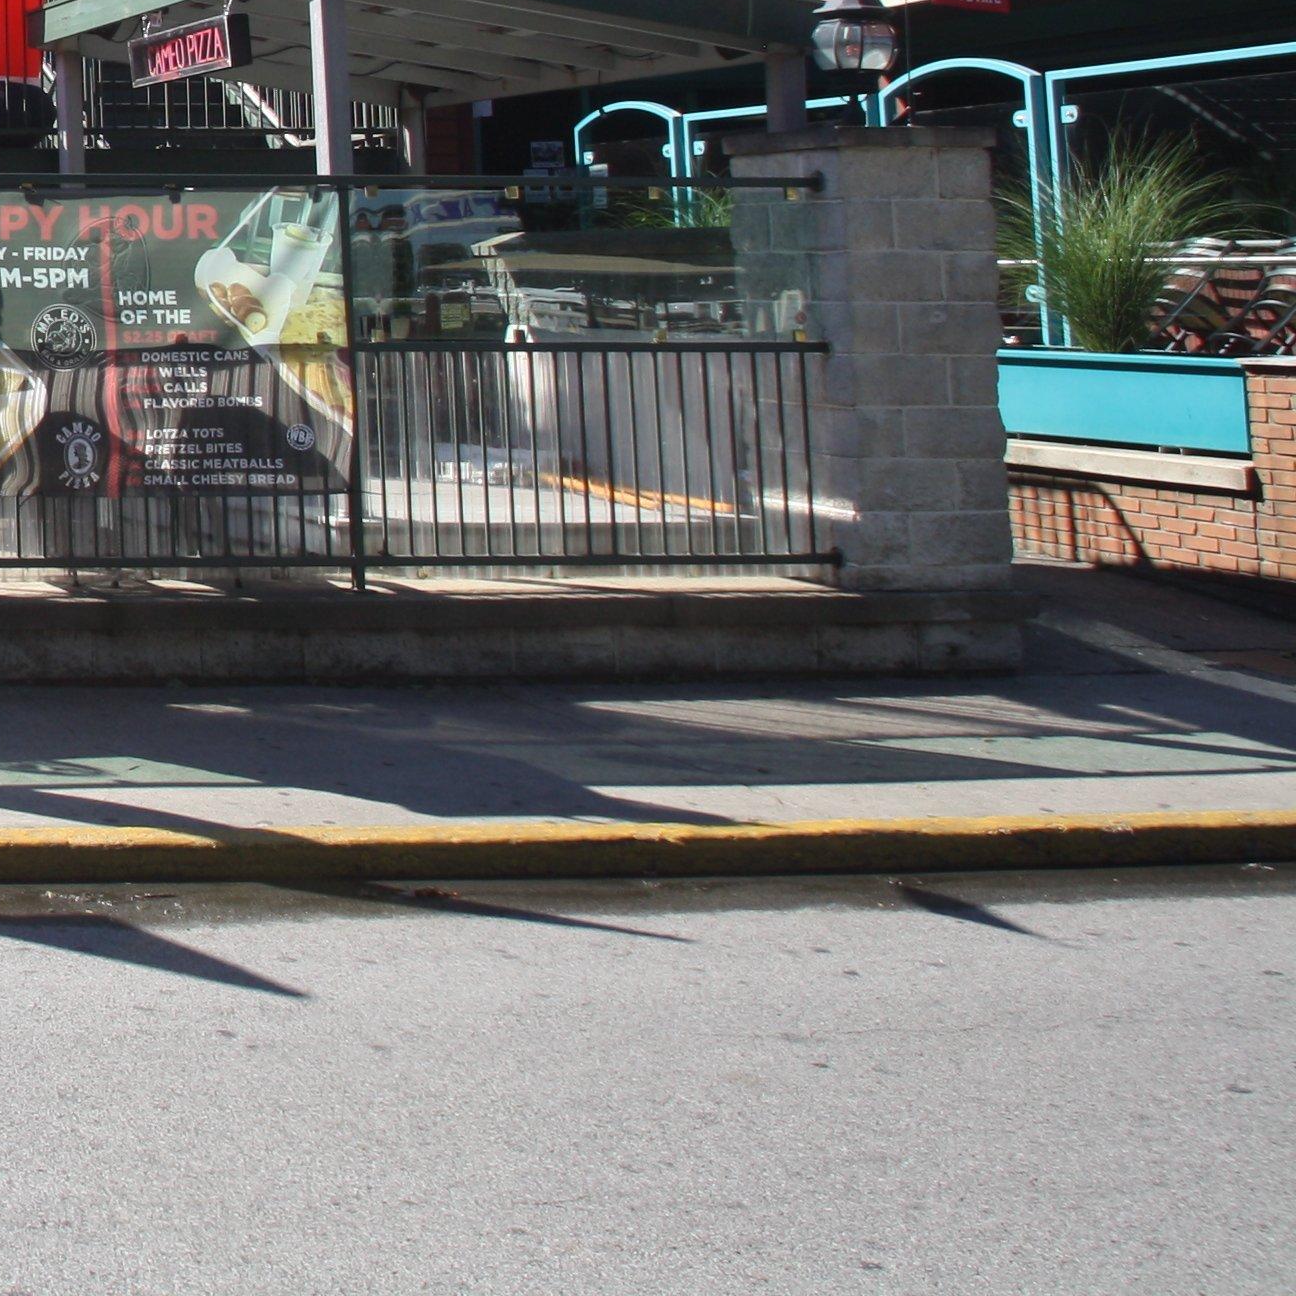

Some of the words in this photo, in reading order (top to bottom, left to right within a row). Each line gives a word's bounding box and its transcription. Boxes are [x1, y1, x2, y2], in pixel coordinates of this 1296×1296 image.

[148, 38, 185, 77] CAMEO
[186, 27, 225, 66] PIZZA
[78, 204, 220, 241] HOUR
[23, 246, 90, 262] FRIDAY
[118, 290, 178, 306] HOME
[120, 309, 148, 325] OF
[152, 309, 191, 324] THE
[142, 351, 210, 363] DOMESTIC
[214, 350, 250, 362] CANS
[159, 366, 208, 378] WELLS
[163, 382, 208, 394] CALLS
[143, 397, 215, 409] FLAVORED
[217, 396, 263, 408] BOMBS
[56, 422, 101, 443] CAMEO
[146, 428, 188, 440] LOTZA
[192, 427, 224, 439] TOTS
[145, 443, 203, 455] PRETZEL
[206, 442, 243, 454] BITES
[145, 459, 200, 471] CLASSIC
[202, 458, 284, 470] MEATBALLS
[144, 475, 189, 487] SMALL
[192, 474, 245, 486] CHEESY
[248, 474, 296, 485] BREAD
